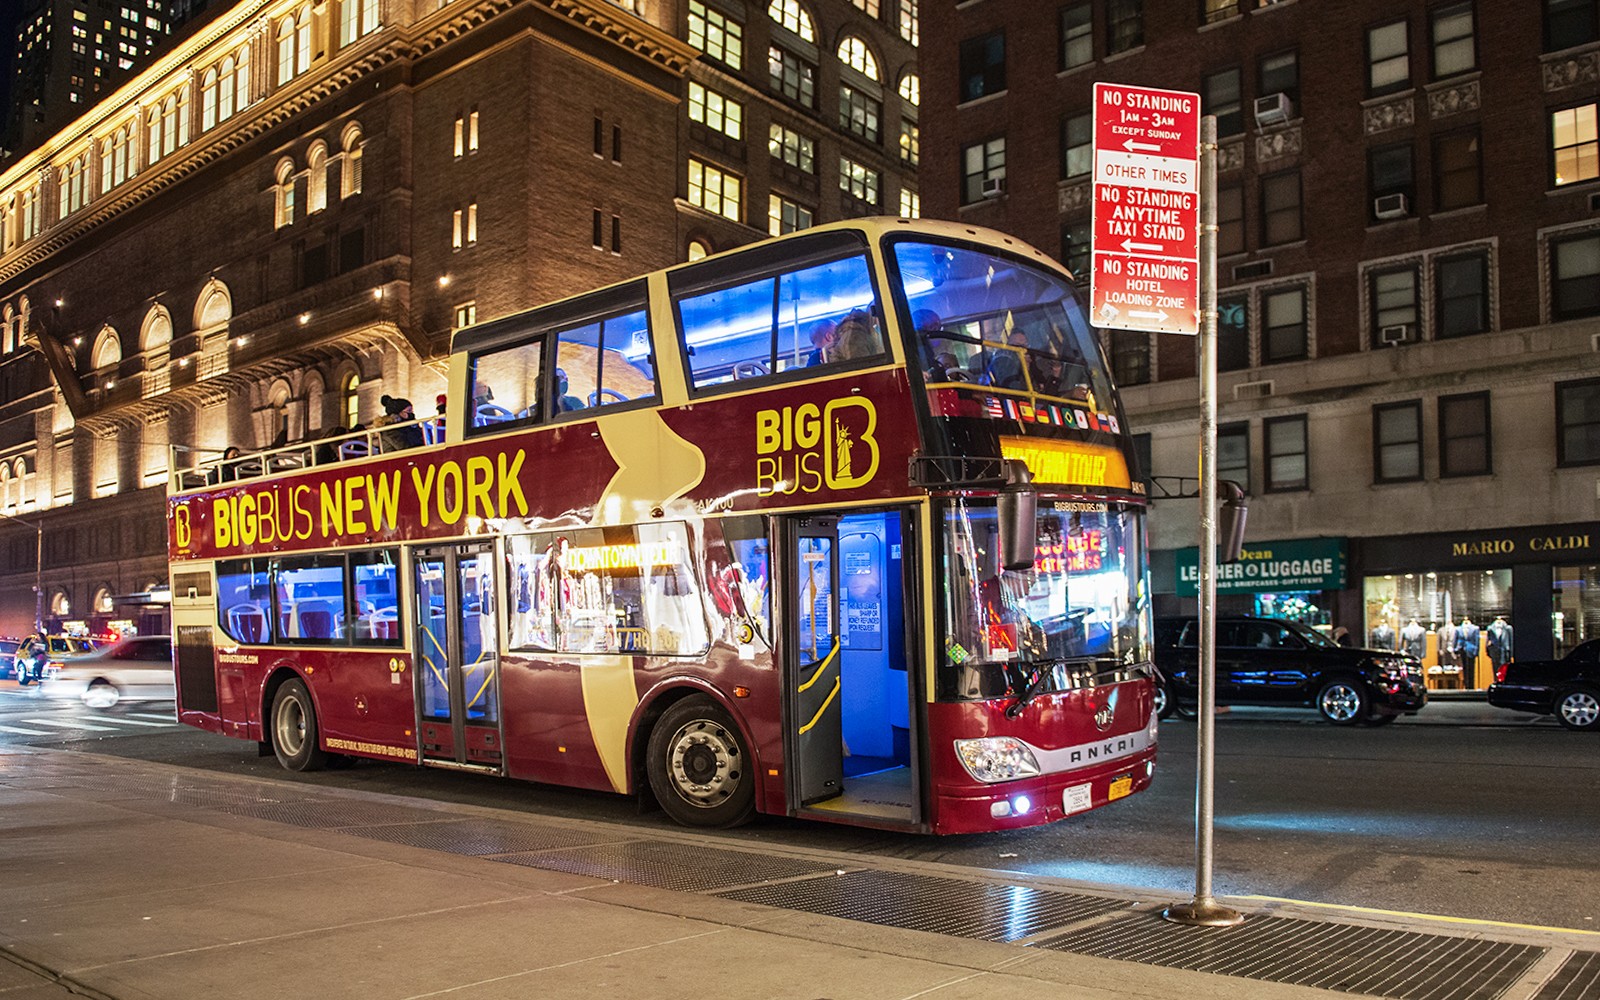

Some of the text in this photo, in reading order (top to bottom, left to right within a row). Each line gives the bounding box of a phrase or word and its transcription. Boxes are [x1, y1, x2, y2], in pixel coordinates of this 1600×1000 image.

[1103, 90, 1191, 114] NO STANDING
[1120, 109, 1140, 124] 1AM
[1151, 112, 1175, 128] 3AM
[1112, 125, 1181, 141] EXCEPT SUNDAY
[1105, 163, 1187, 185] OTHER TIMES
[1101, 187, 1191, 210] NO STANDING
[1112, 205, 1180, 225] ANYTIME
[1107, 220, 1185, 241] TAXI STAND
[1103, 259, 1189, 281] NO STANDING
[1126, 279, 1164, 293] HOTEL
[1105, 291, 1185, 309] LOADING ZONE
[756, 403, 821, 454] BIG
[757, 452, 822, 497] BUS
[1071, 453, 1107, 485] TOUR
[320, 469, 401, 538] NEW
[411, 448, 529, 528] YORK
[568, 544, 641, 570] DOWNTOWN
[1238, 550, 1273, 561] Dean
[1452, 534, 1590, 557] MARIO CALDI
[1181, 563, 1244, 581] LEHER
[1261, 558, 1333, 577] LUGGAGE
[1070, 738, 1134, 763] ANKAI
